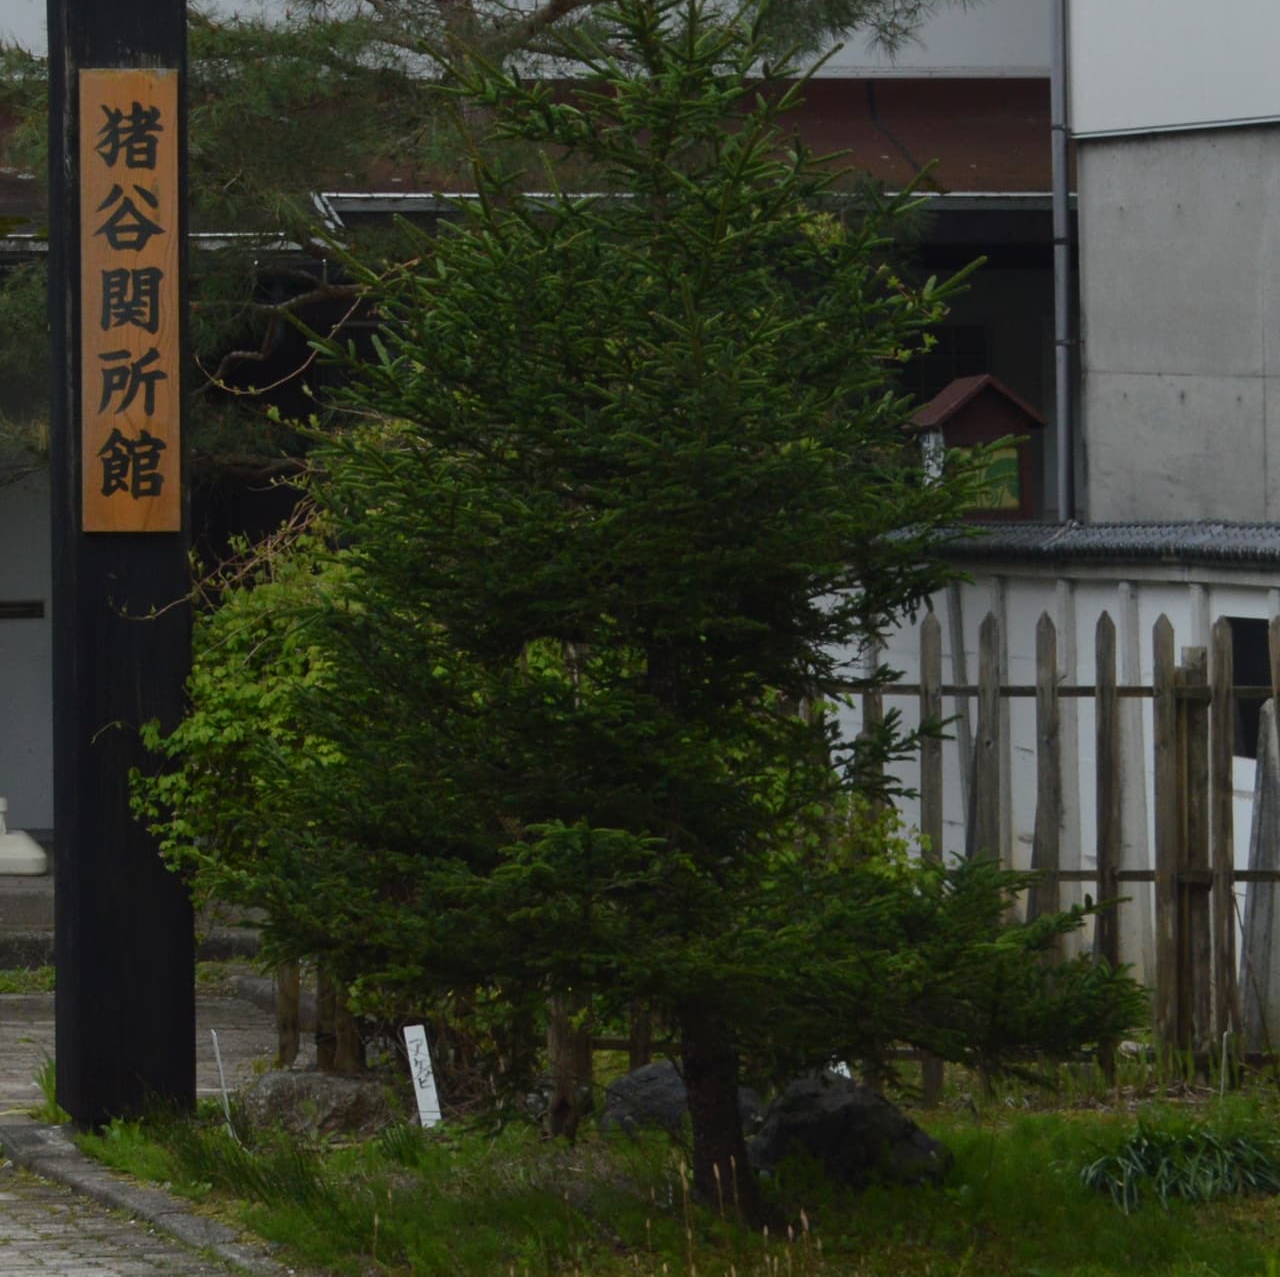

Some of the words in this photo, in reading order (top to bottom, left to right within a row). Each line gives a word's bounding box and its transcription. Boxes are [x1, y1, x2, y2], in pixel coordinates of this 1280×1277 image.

[95, 102, 167, 500] 猪谷関所館
